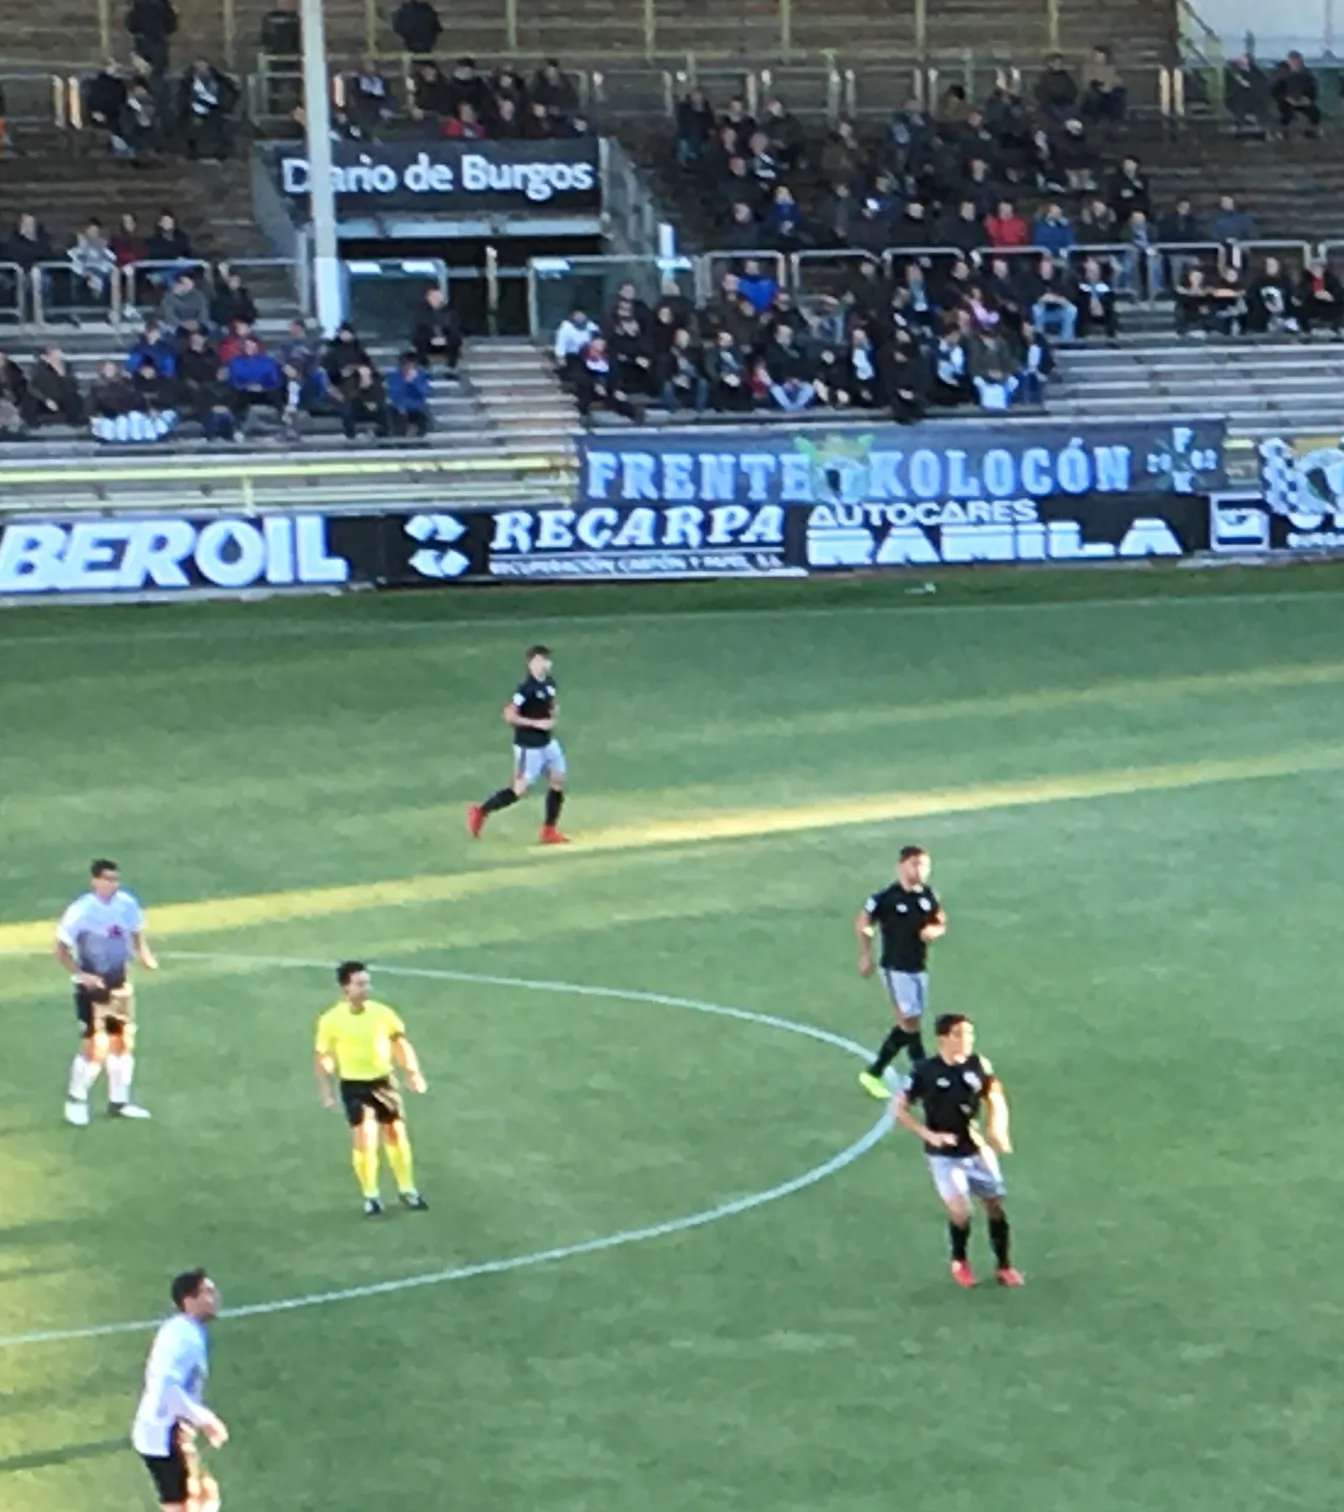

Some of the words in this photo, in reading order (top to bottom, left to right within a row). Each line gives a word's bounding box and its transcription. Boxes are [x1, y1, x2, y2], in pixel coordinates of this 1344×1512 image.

[282, 153, 398, 193] Dario
[404, 152, 453, 191] de
[462, 154, 594, 201] Burgos
[586, 447, 812, 501] FRENTE
[868, 437, 1131, 500] KOLOCÓN
[489, 504, 785, 553] RECARPA
[808, 500, 1039, 527] AUTOCARES
[0, 514, 349, 593] BEROIL
